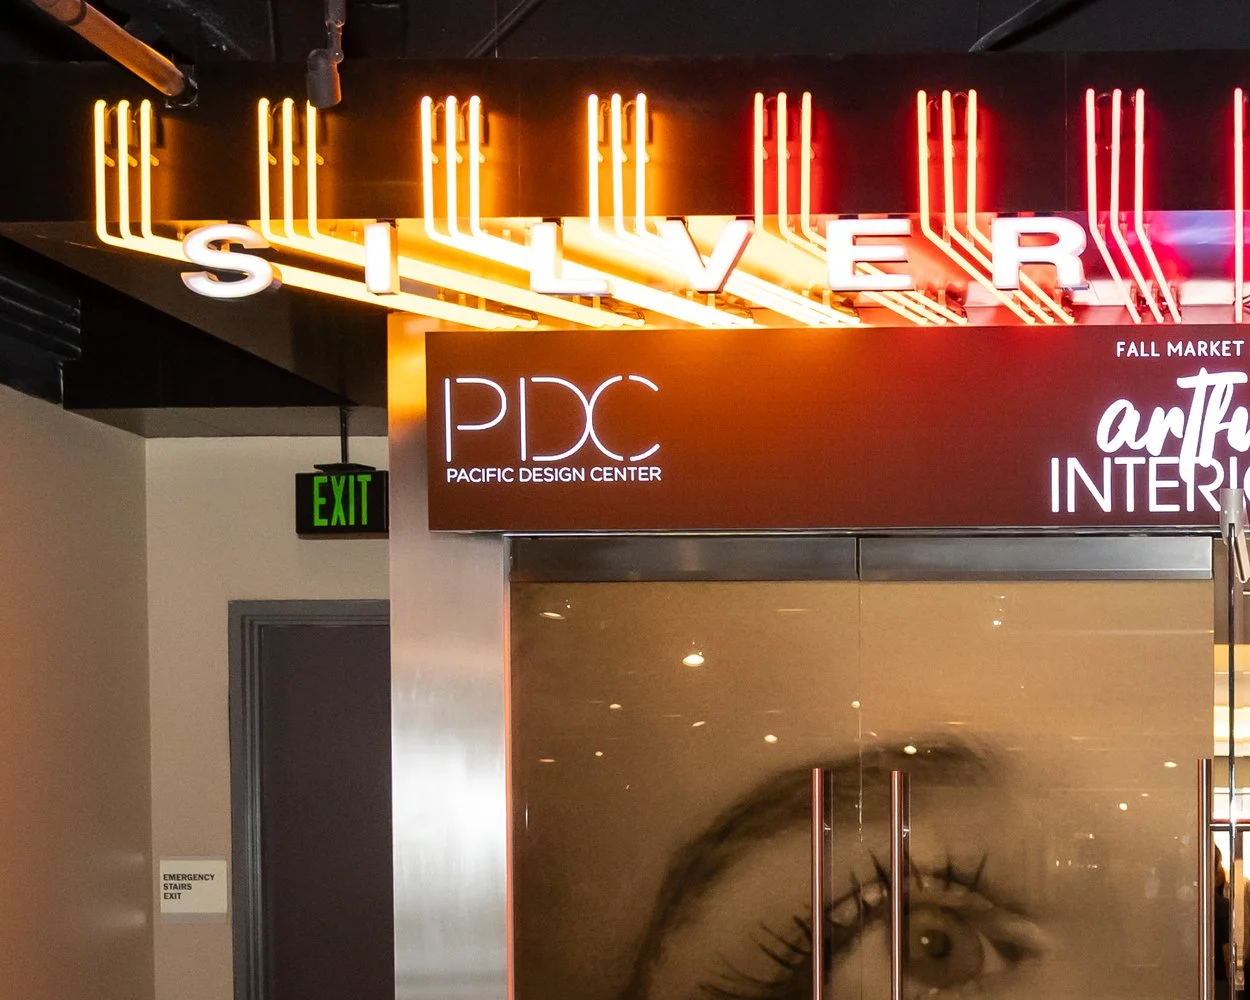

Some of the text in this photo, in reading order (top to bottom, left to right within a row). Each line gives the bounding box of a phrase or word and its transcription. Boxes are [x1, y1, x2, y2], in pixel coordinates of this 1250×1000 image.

[181, 214, 1090, 300] SILVER
[1116, 341, 1160, 357] FALL
[1167, 341, 1244, 357] MARKET
[445, 374, 660, 463] PDC
[446, 466, 662, 483] PACIFIC DESIGN CENTER
[313, 474, 372, 526] EXIT
[163, 873, 215, 881] EMERGENCY
[163, 883, 192, 891] STAIRS
[163, 892, 182, 900] EXIT
